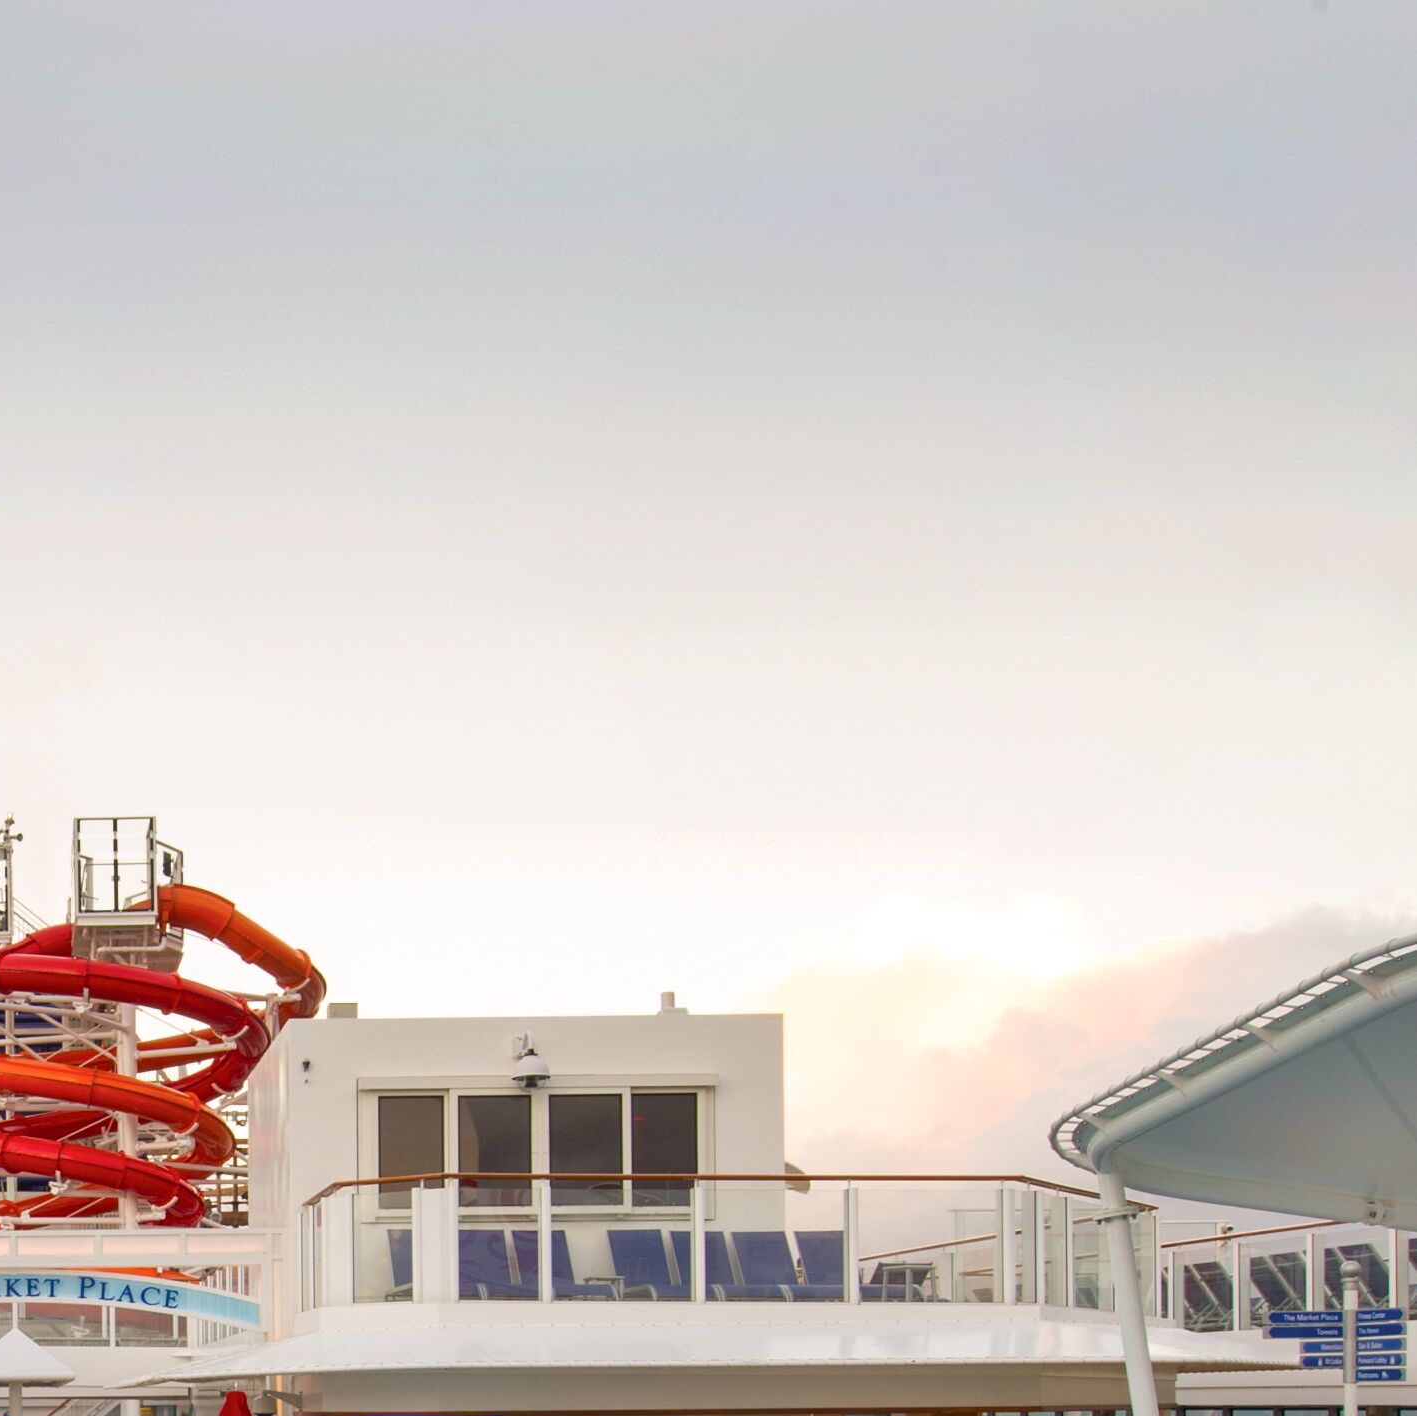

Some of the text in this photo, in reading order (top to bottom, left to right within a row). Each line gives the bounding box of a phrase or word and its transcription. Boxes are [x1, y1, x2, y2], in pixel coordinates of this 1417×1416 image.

[77, 1276, 179, 1309] PLACE
[1296, 1313, 1319, 1321] Market
[1320, 1313, 1338, 1321] Place
